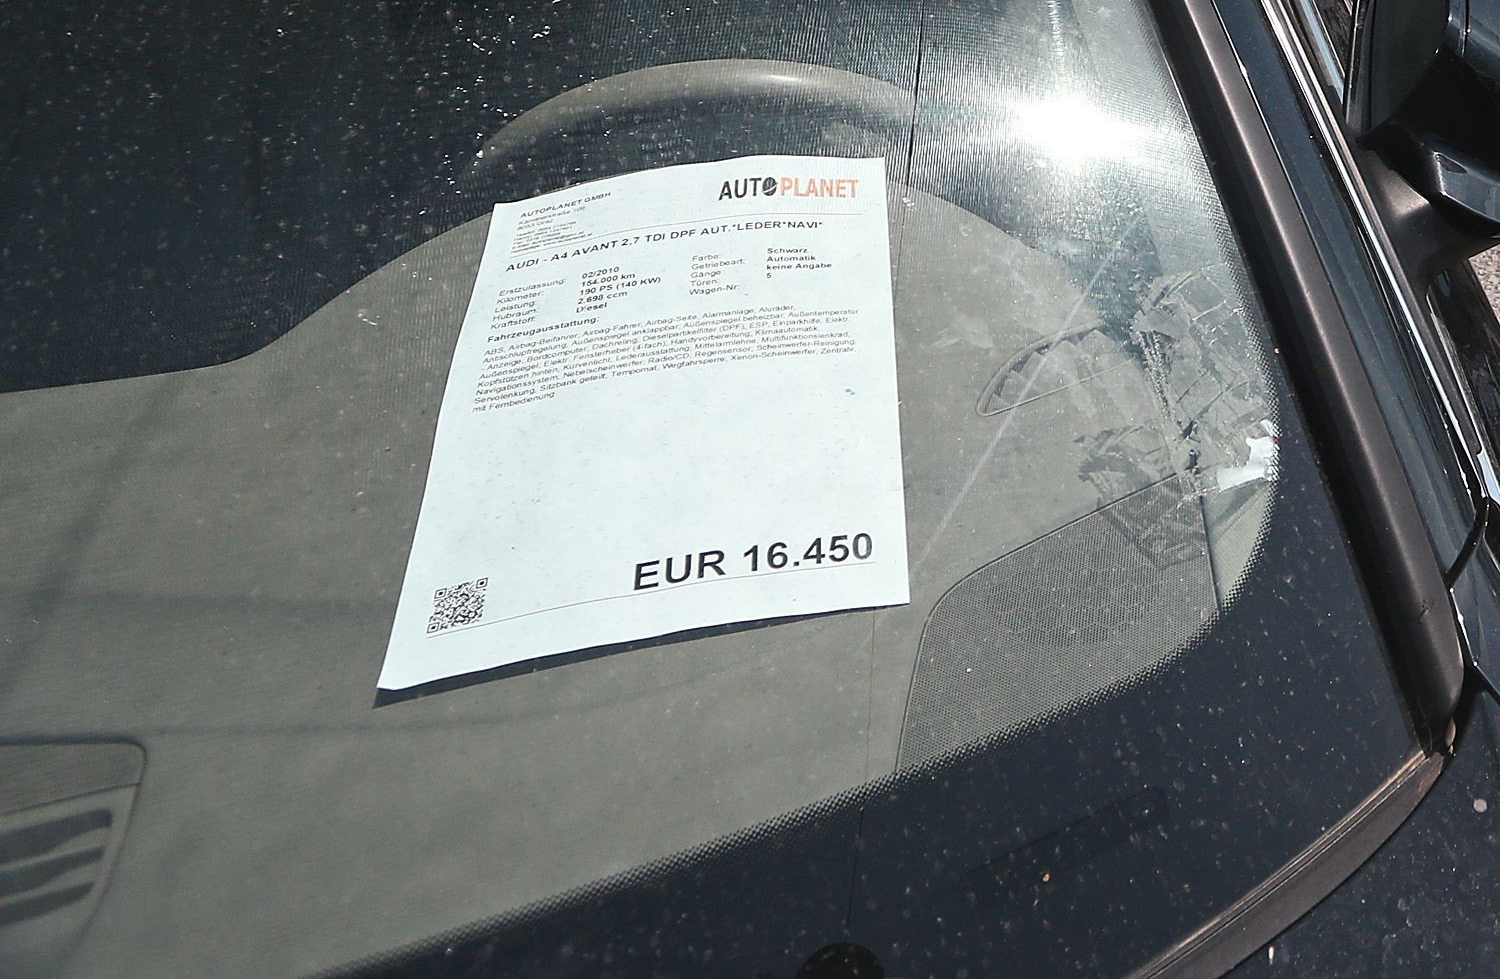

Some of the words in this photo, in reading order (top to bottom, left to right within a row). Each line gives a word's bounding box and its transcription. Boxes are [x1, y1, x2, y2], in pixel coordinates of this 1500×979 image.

[718, 176, 859, 201] AUTOPLANET
[520, 199, 583, 218] AUTOPLANET
[584, 192, 611, 203] GMBH
[506, 258, 539, 272] AUDI
[550, 252, 568, 262] A4
[571, 240, 619, 257] AVANT
[621, 236, 640, 247] 2,7
[644, 233, 666, 243] TDI
[670, 229, 697, 239] DPF
[692, 254, 721, 262] Farbe:
[691, 258, 746, 270] Getriebeart:
[795, 262, 833, 270] Angabe
[499, 278, 567, 297] Erstzulassung:
[581, 266, 620, 279] 02/2010
[492, 308, 539, 322] Hubraum:
[577, 294, 604, 305] 2.698
[606, 291, 628, 299] ccm
[494, 300, 538, 314] Leistung:
[579, 287, 597, 296] 190
[599, 284, 613, 292] PS
[615, 280, 638, 290] (140
[640, 276, 661, 285] KW)
[496, 291, 544, 305] Kilometer:
[490, 316, 536, 330] Kraftstoff:
[576, 302, 608, 313] Diesel
[571, 331, 630, 346] Außenspiegel
[683, 317, 741, 329] Außenspiegel
[788, 309, 859, 318] Außentemperatur
[487, 317, 600, 343] Fahrzeugausstattung:
[642, 326, 718, 342] Dieselpartikelfilter
[572, 346, 630, 361] Fensterheber
[477, 375, 529, 388] Kopfstützen
[539, 379, 577, 392] Sitzbank
[472, 404, 486, 413] mit
[488, 391, 555, 410] Fernbedienung
[633, 549, 726, 591] EUR
[743, 532, 873, 572] 16.450
